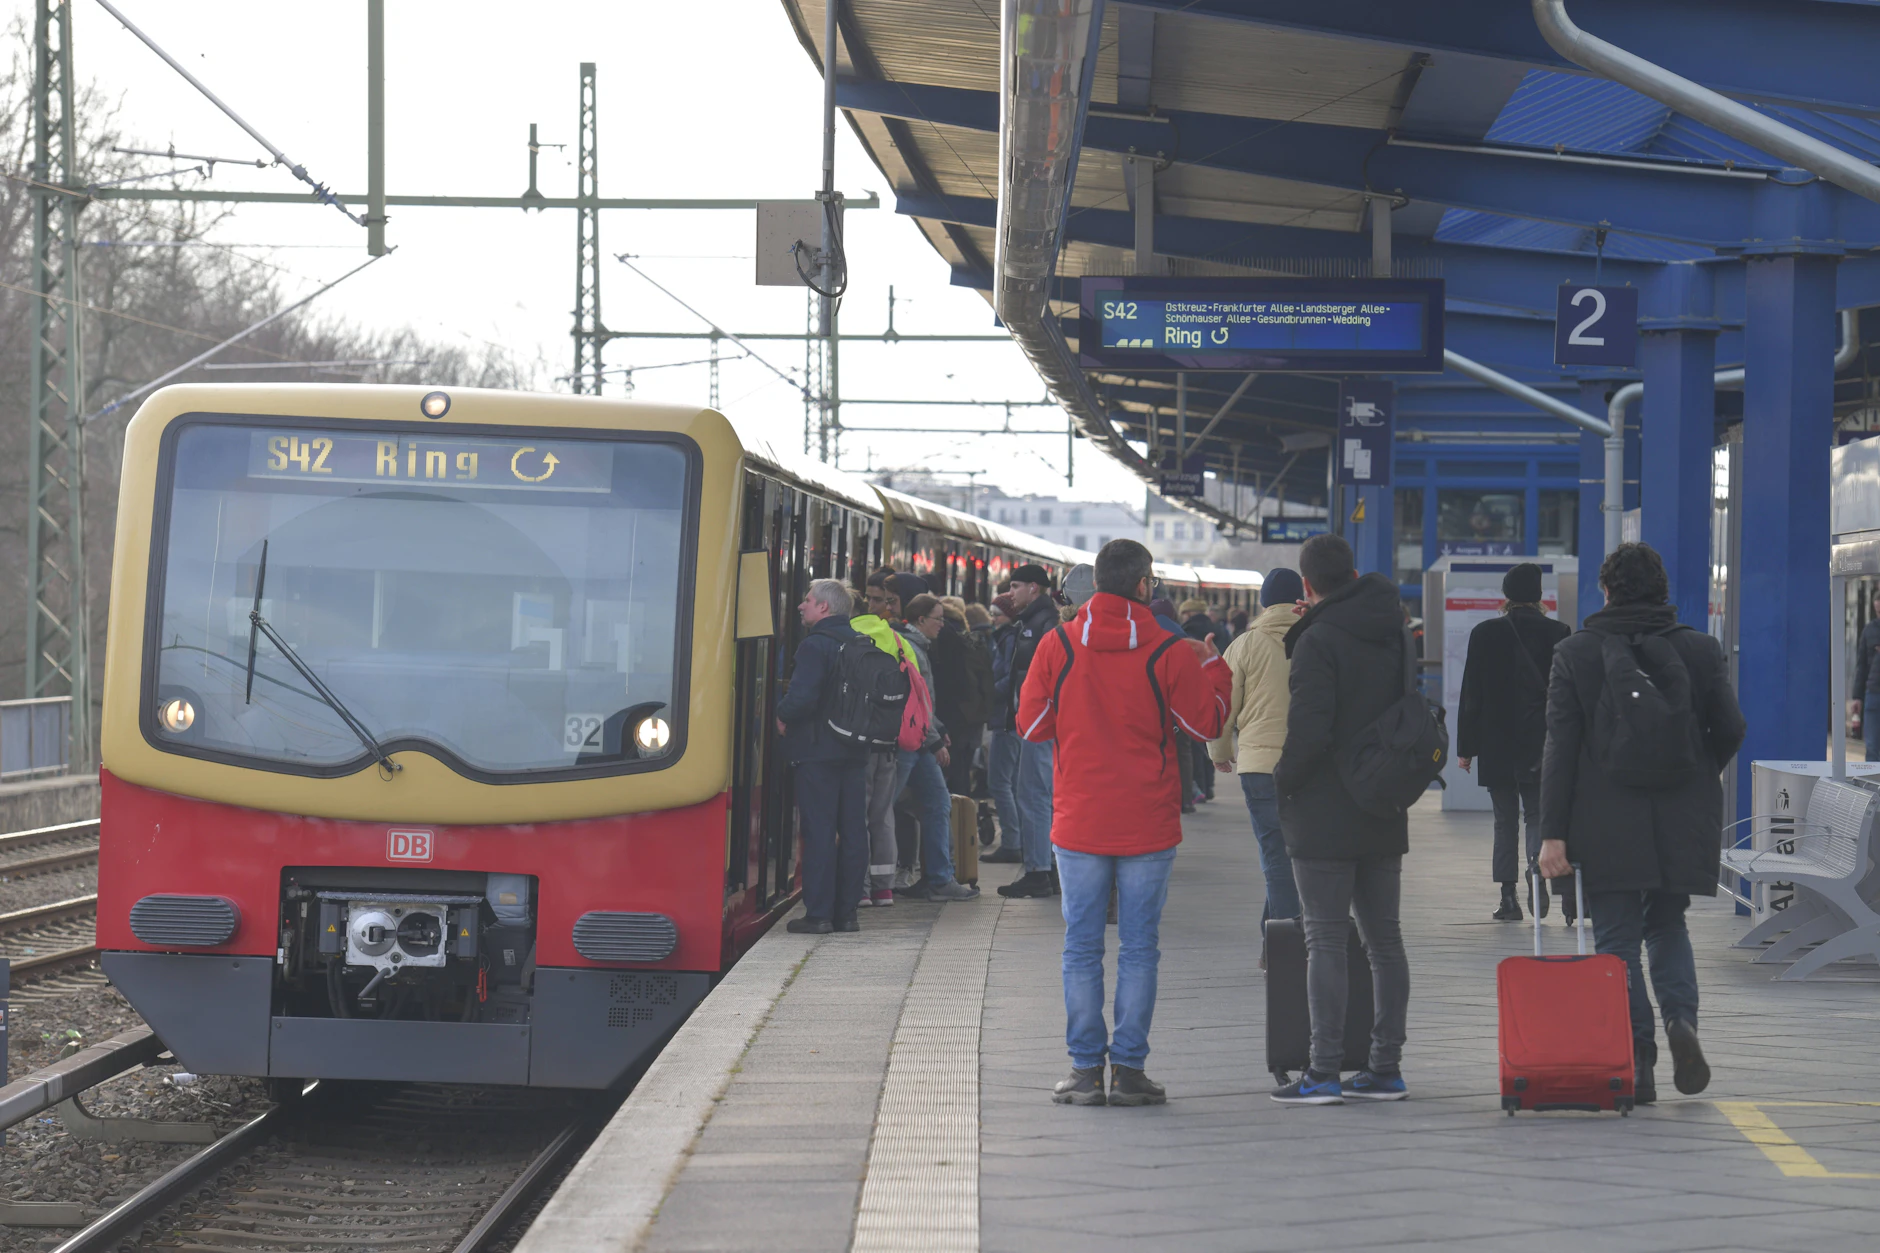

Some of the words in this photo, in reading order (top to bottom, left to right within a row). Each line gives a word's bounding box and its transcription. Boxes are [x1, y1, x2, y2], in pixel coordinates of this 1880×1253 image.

[1103, 301, 1138, 320] S42
[1165, 313, 1223, 323] Schönhauser
[1568, 288, 1606, 346] 2
[1165, 326, 1201, 349] Ring
[267, 436, 333, 474] S42
[376, 440, 478, 480] Ring
[566, 716, 601, 747] 32
[393, 834, 428, 857] DB
[1770, 817, 1794, 912] Aball
